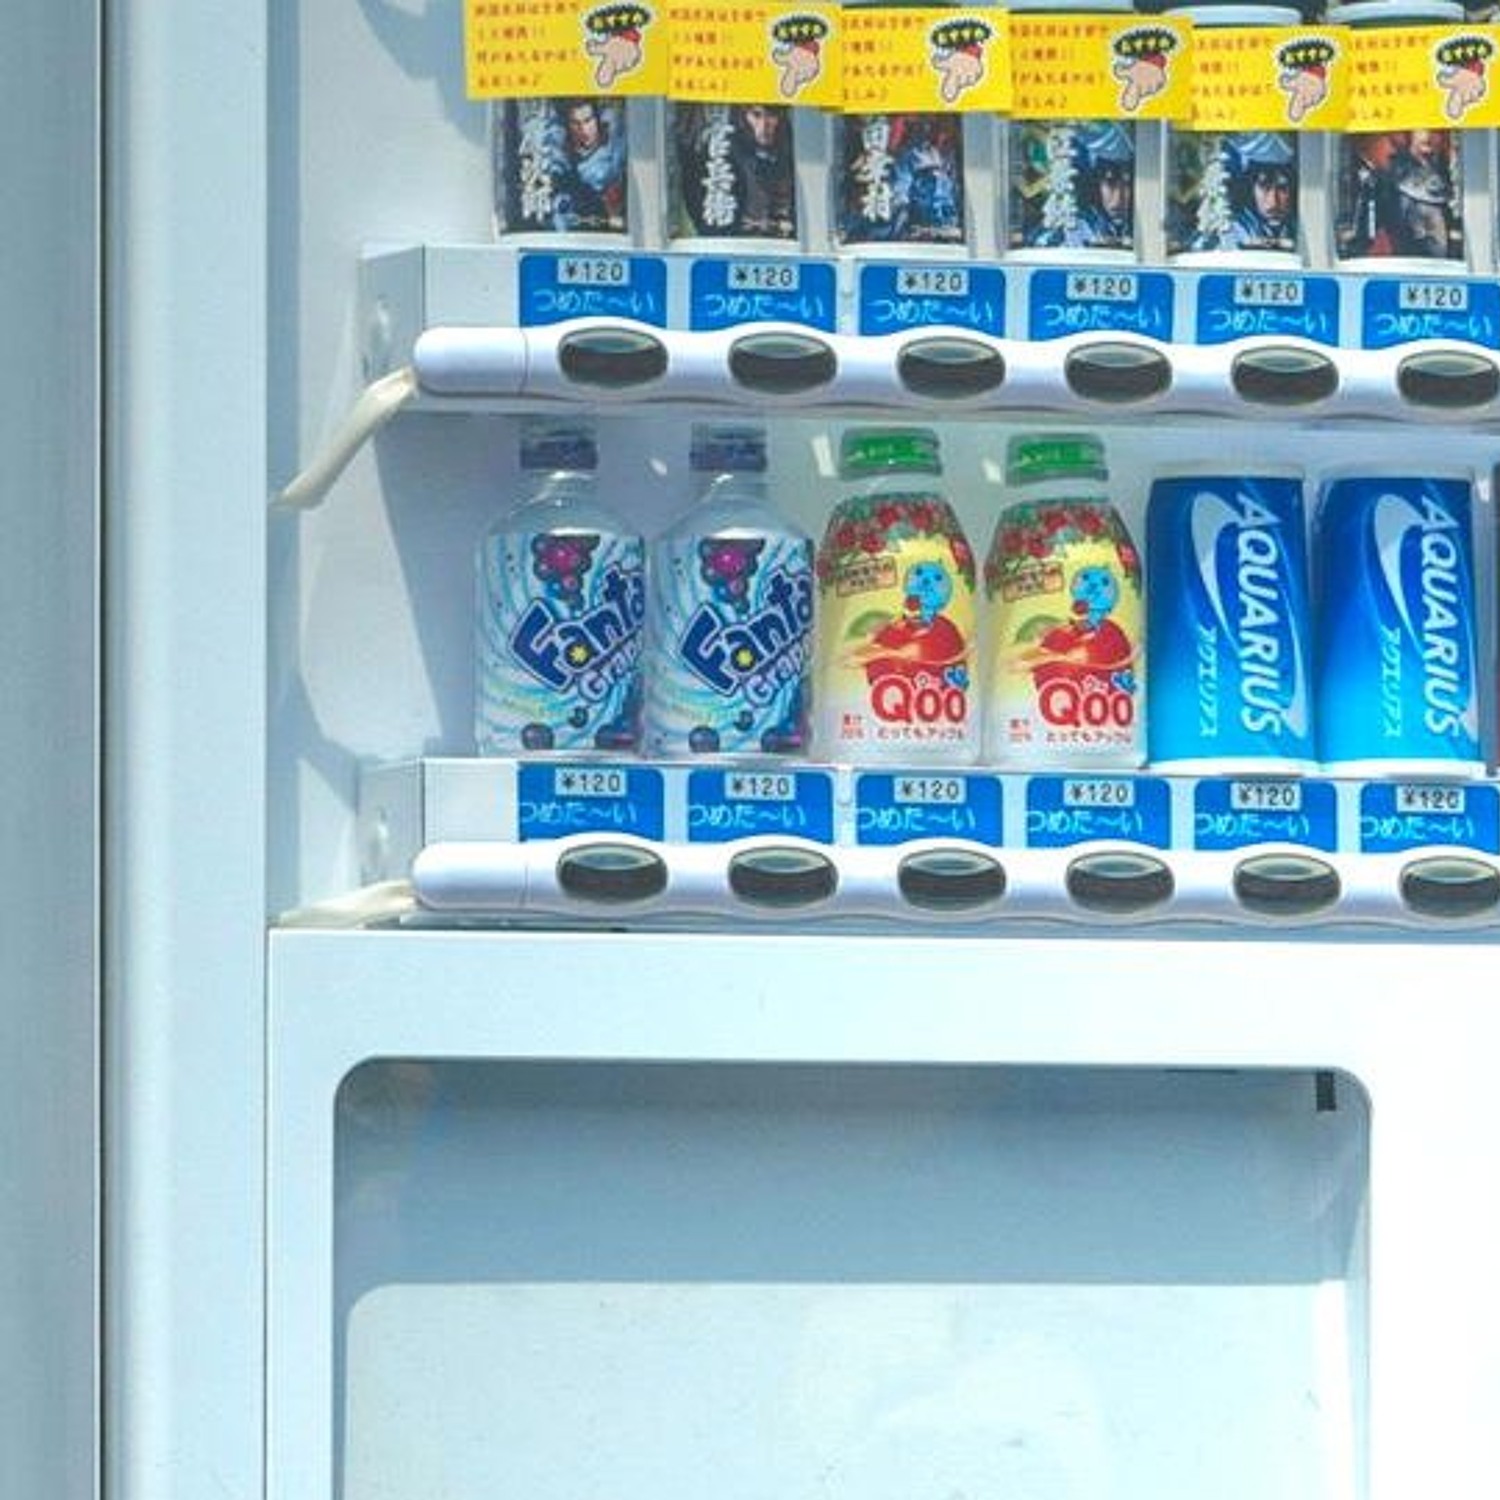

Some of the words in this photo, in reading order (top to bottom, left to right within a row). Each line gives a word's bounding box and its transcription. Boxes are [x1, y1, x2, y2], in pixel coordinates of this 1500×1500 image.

[565, 260, 623, 282] ¥120
[735, 266, 793, 285] ¥120
[904, 271, 962, 291] ¥120
[1074, 277, 1131, 296] ¥120
[1241, 282, 1295, 300] ¥120
[1407, 287, 1462, 305] ¥120
[1235, 491, 1282, 737] AQUARIUS
[1420, 494, 1460, 738] AQUARIUS
[508, 565, 645, 692] Fanta
[680, 568, 812, 697] Fanta
[871, 674, 967, 724] Qoo
[1039, 681, 1135, 729] Qoo
[562, 774, 620, 793] ¥120
[732, 777, 789, 796] ¥120
[902, 780, 959, 800] ¥120
[1072, 783, 1128, 803] ¥120
[1240, 785, 1295, 806] ¥120
[1405, 788, 1459, 809] ¥120
